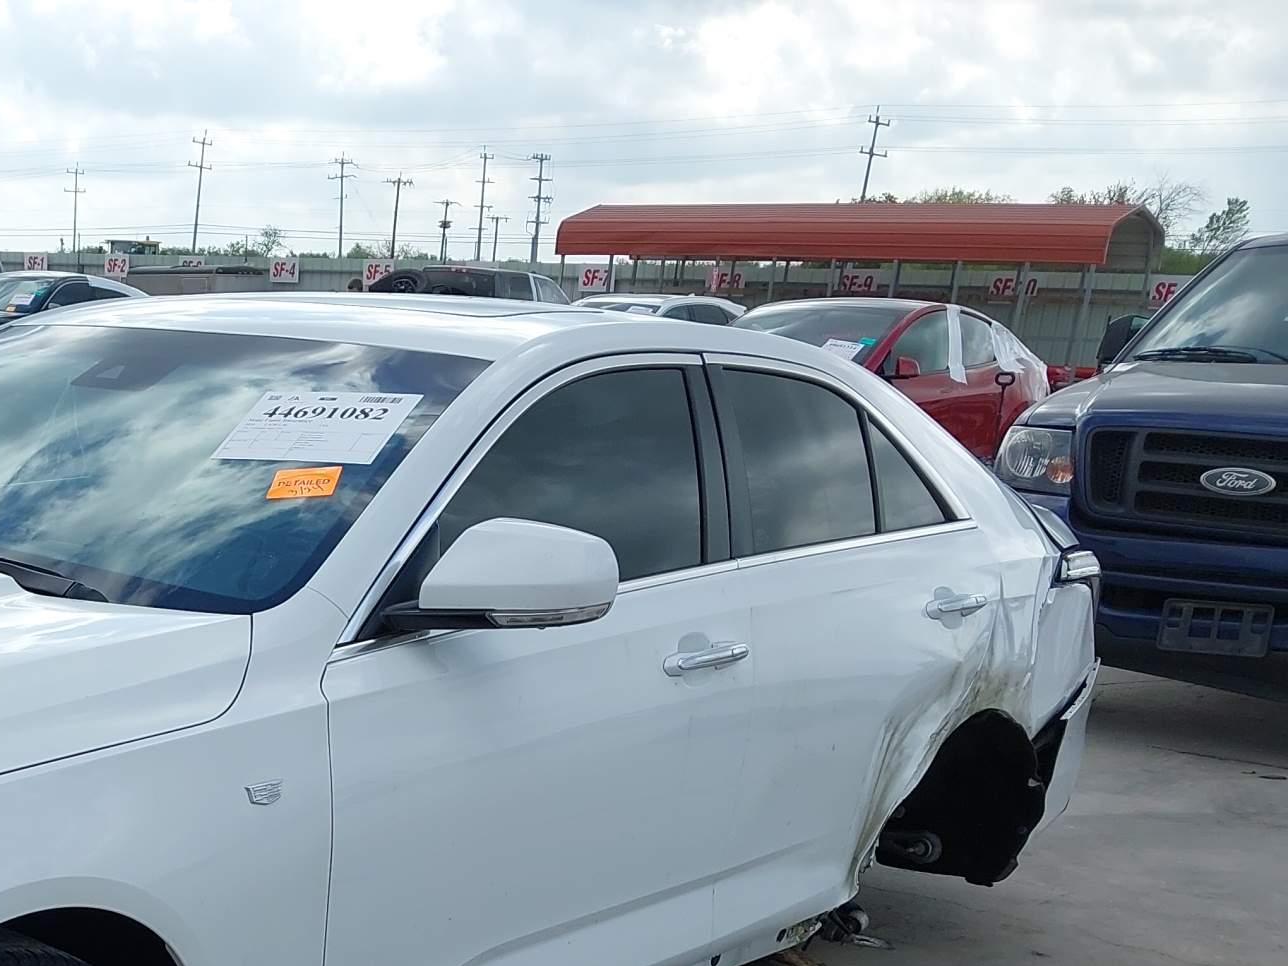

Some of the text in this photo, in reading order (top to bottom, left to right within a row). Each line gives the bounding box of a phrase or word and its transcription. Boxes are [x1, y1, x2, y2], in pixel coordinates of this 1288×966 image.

[28, 256, 45, 270] SF-1
[107, 258, 126, 273] SF-2
[273, 261, 296, 278] SF-4
[582, 268, 609, 287] SF-7
[708, 272, 742, 289] F-8
[842, 274, 873, 291] SF-9
[263, 405, 390, 421] 44691082
[1216, 471, 1259, 489] Ford
